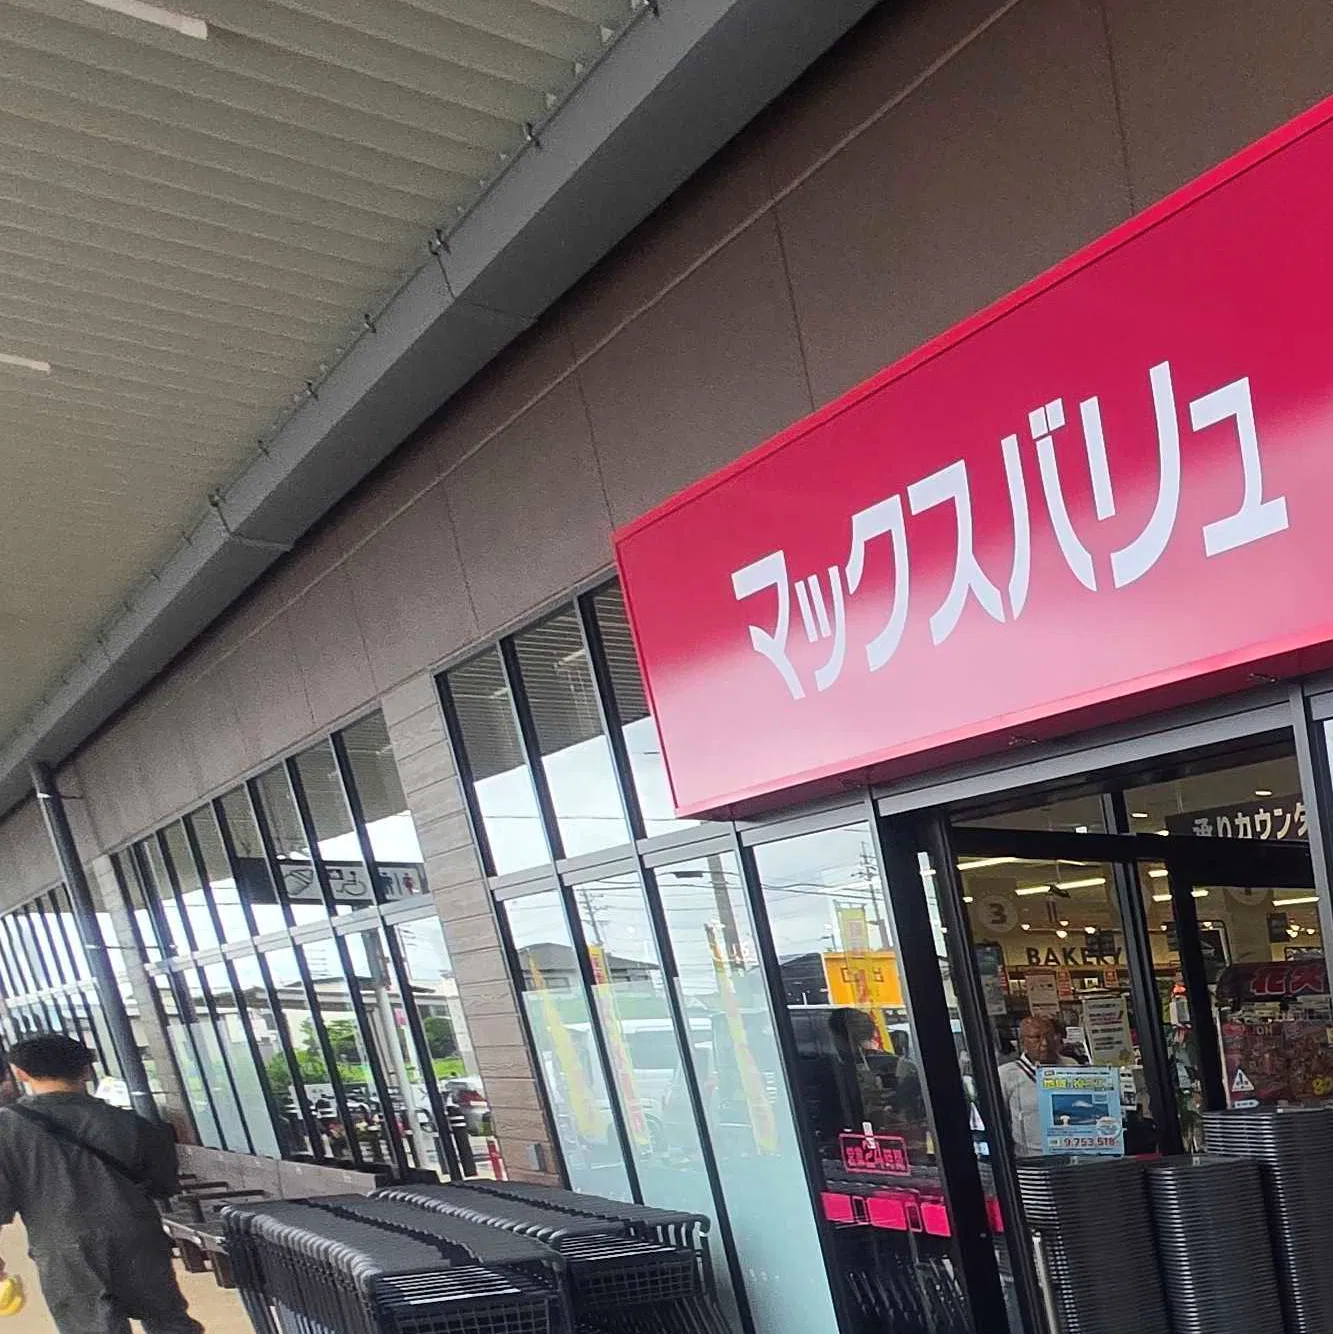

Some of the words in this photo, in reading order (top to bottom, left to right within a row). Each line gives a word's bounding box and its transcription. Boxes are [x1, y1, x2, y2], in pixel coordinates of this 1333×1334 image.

[731, 360, 1288, 699] マックスバリュ
